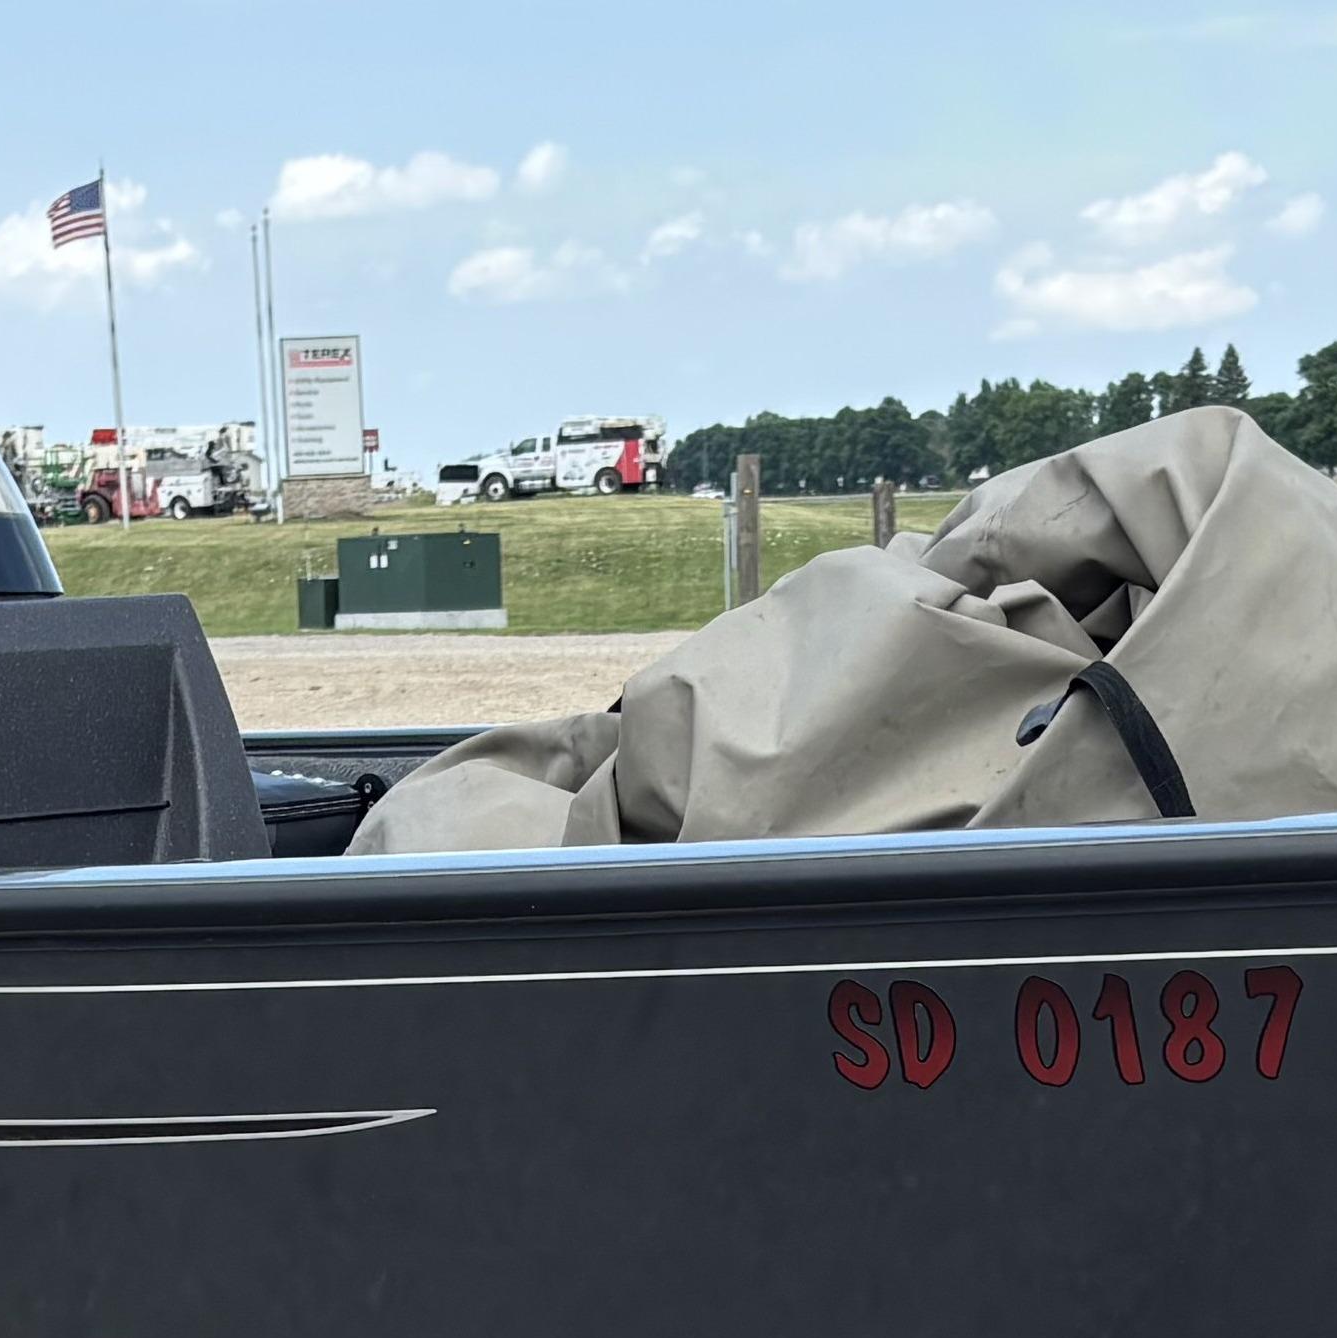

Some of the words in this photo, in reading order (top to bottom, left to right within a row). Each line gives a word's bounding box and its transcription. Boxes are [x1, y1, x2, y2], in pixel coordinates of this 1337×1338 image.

[303, 347, 351, 360] TEREX
[827, 979, 957, 1090] SD
[1014, 965, 1304, 1087] 0187
